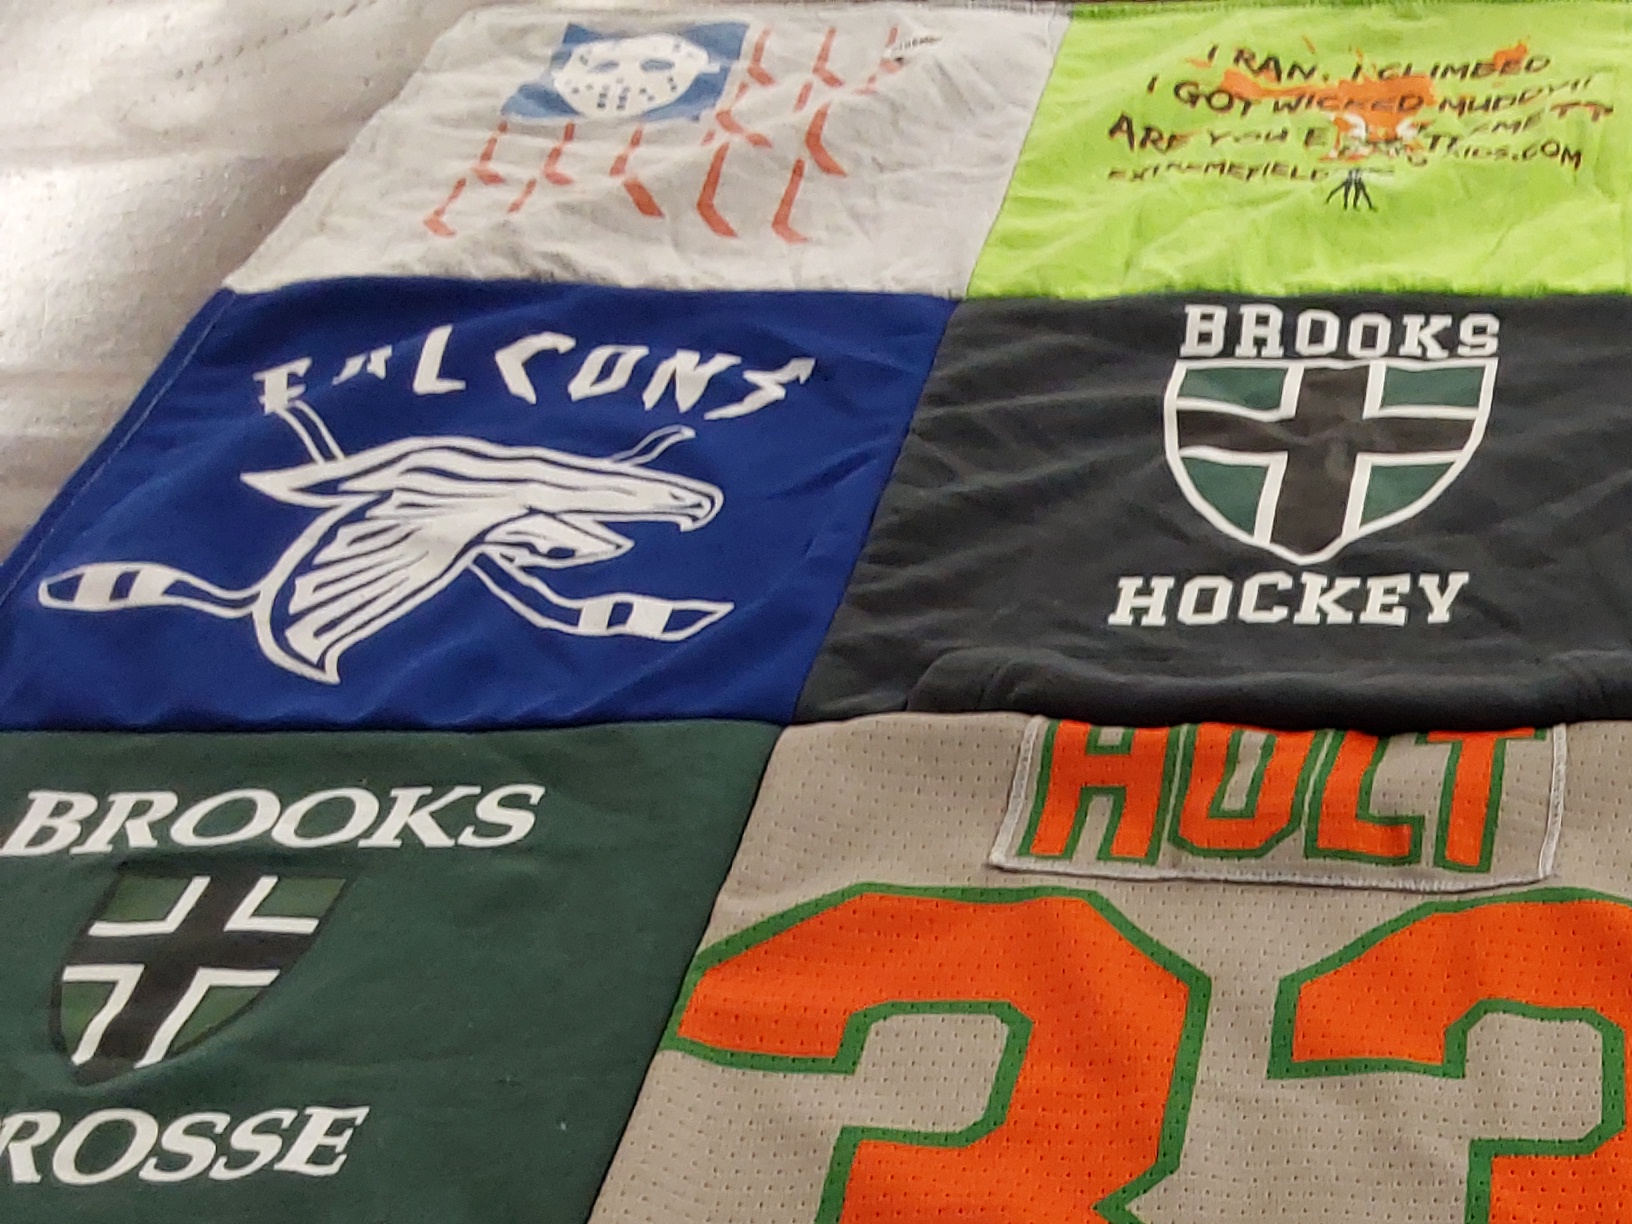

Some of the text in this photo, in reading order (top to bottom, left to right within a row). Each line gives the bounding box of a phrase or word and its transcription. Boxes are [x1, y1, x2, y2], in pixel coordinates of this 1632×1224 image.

[1180, 303, 1500, 359] BROOKS
[254, 324, 816, 420] FALCONS
[1108, 570, 1470, 627] HOCKEY
[0, 784, 546, 857] BROOKS
